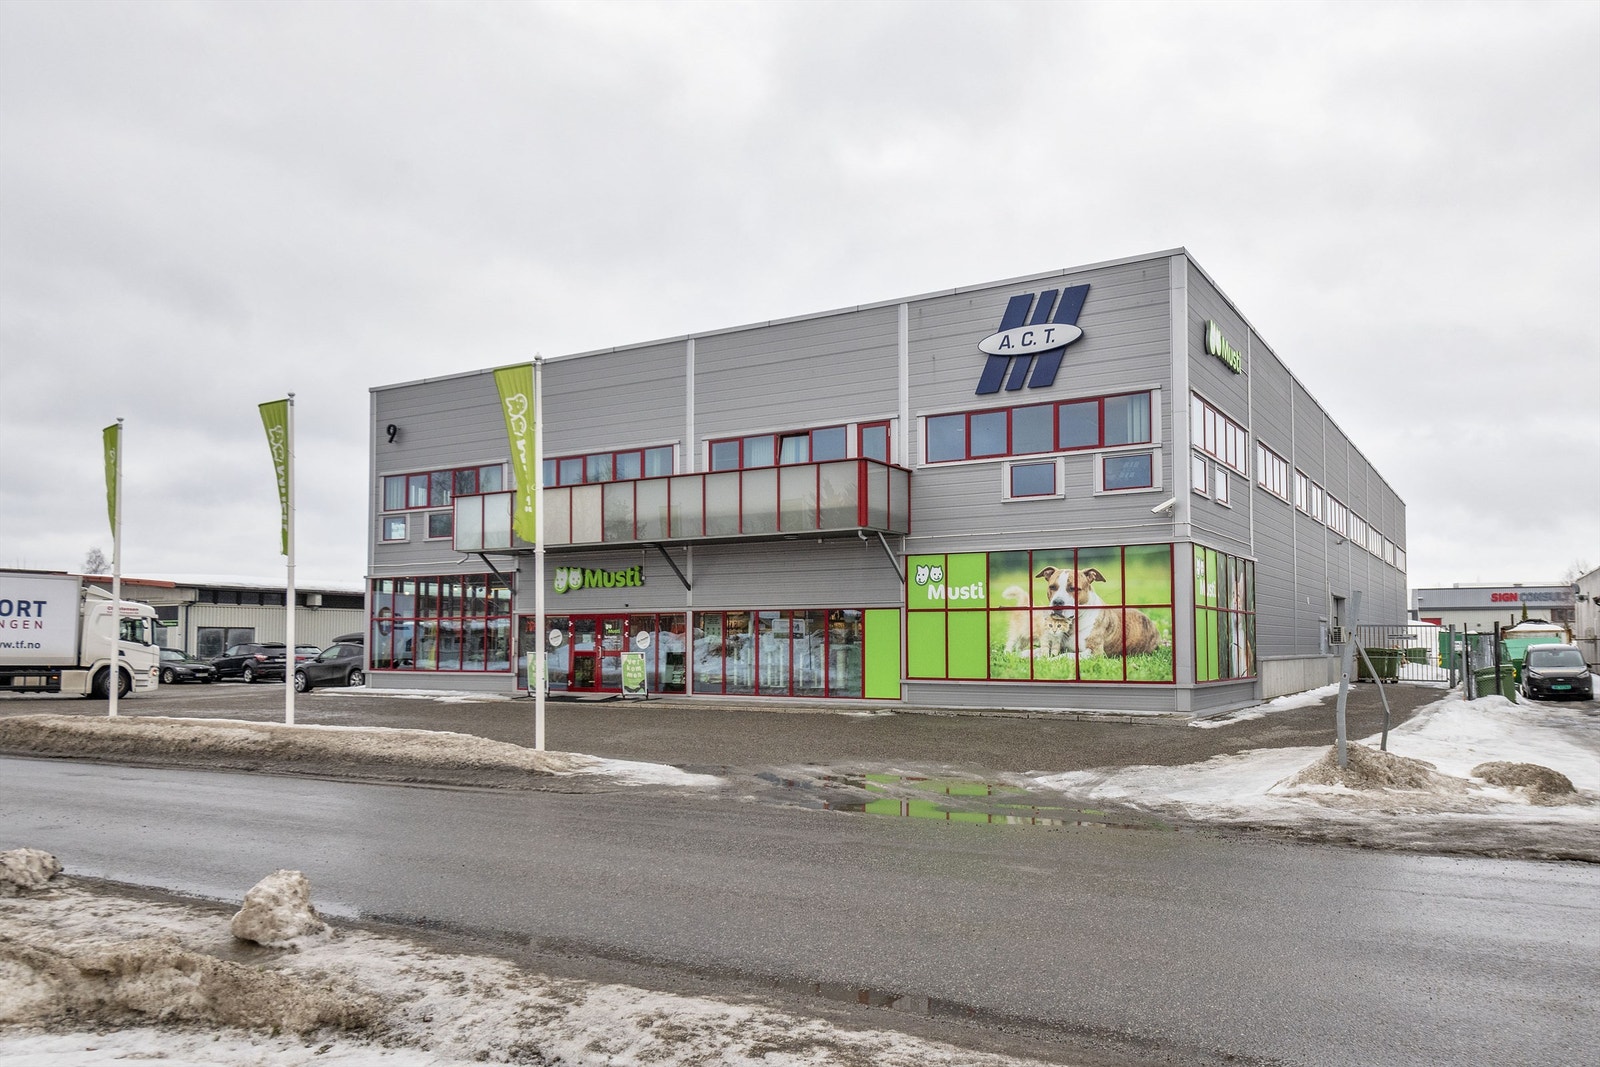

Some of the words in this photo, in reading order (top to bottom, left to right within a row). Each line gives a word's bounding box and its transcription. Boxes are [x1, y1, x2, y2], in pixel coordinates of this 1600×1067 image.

[1221, 336, 1241, 374] Musti
[386, 423, 397, 443] 9
[584, 565, 643, 588] Musti
[927, 582, 985, 600] Musti
[1491, 593, 1518, 602] SIGN
[0, 599, 47, 618] ORT
